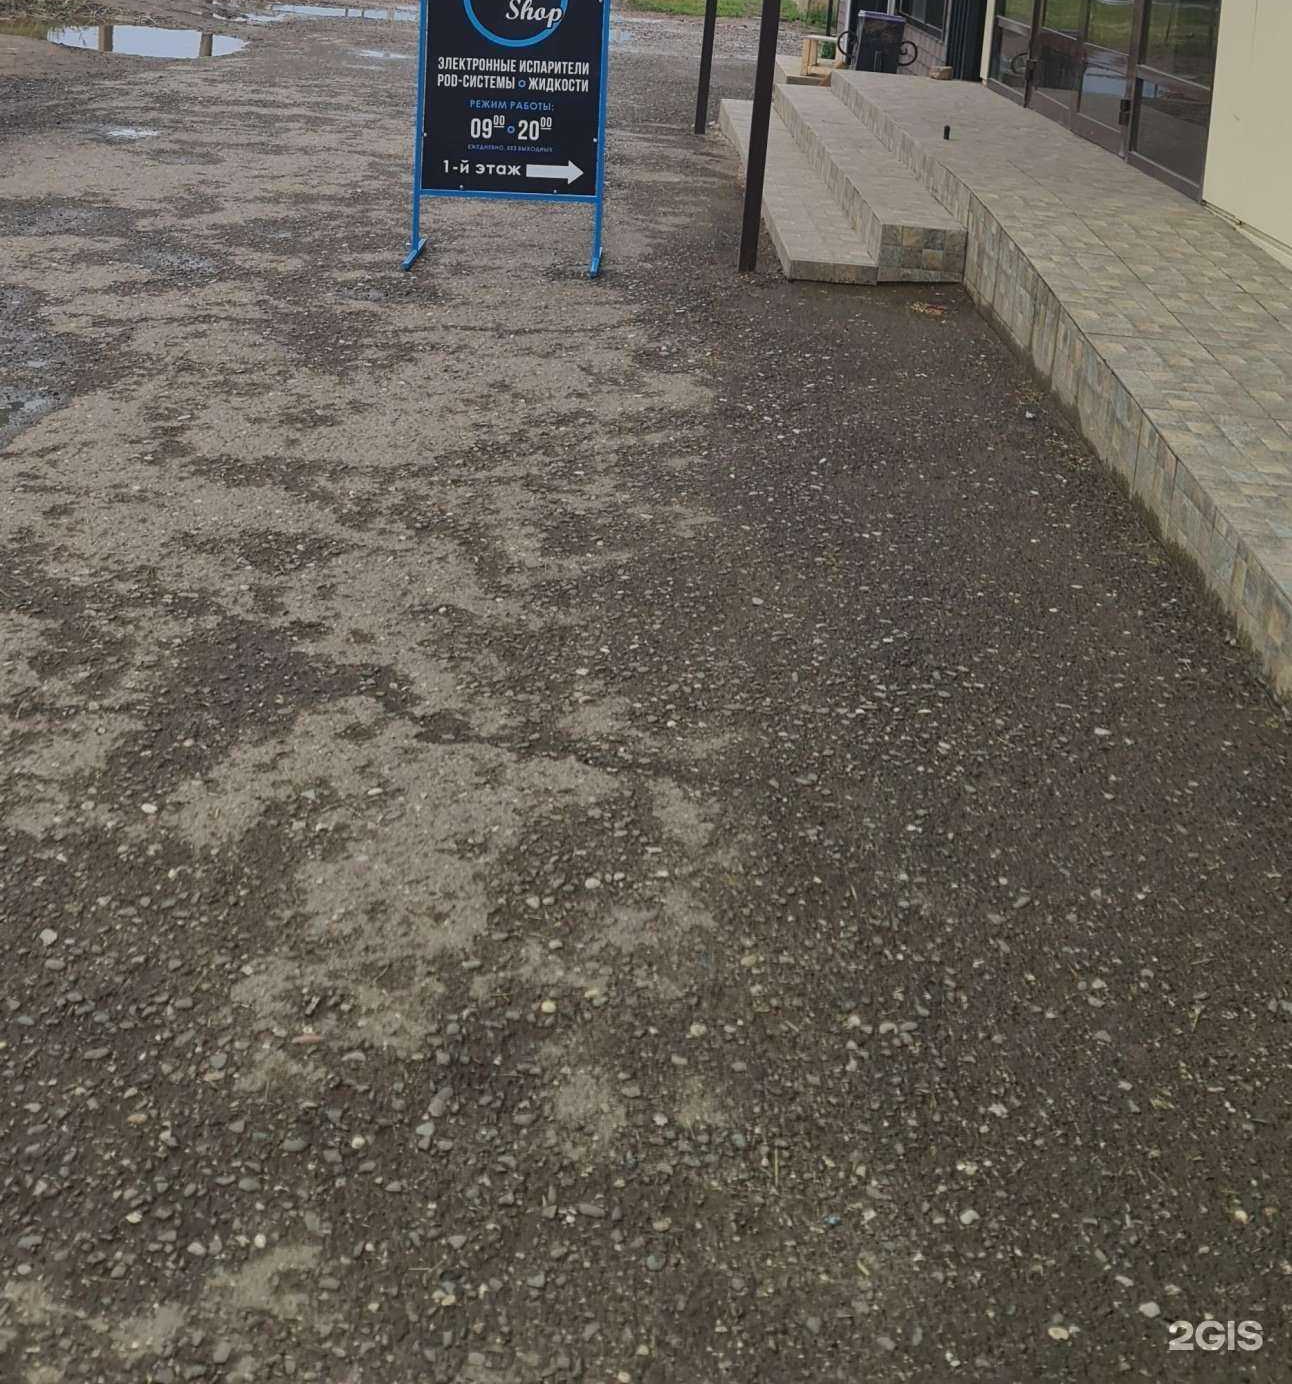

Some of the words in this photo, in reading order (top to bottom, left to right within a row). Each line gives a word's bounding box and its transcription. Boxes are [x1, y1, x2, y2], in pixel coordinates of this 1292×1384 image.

[437, 56, 517, 73] ЭЛЕКТРОННЫЕ
[519, 59, 590, 75] ИСПАРИТЕЛИ
[437, 74, 515, 89] POD-СИСТЕМЫ
[528, 77, 589, 93] ЖИДКОСТИ
[470, 99, 507, 110] РЕЖИМ
[510, 101, 555, 112] РАБОТЫ:
[443, 159, 470, 174] 1-й
[475, 163, 521, 176] этаж
